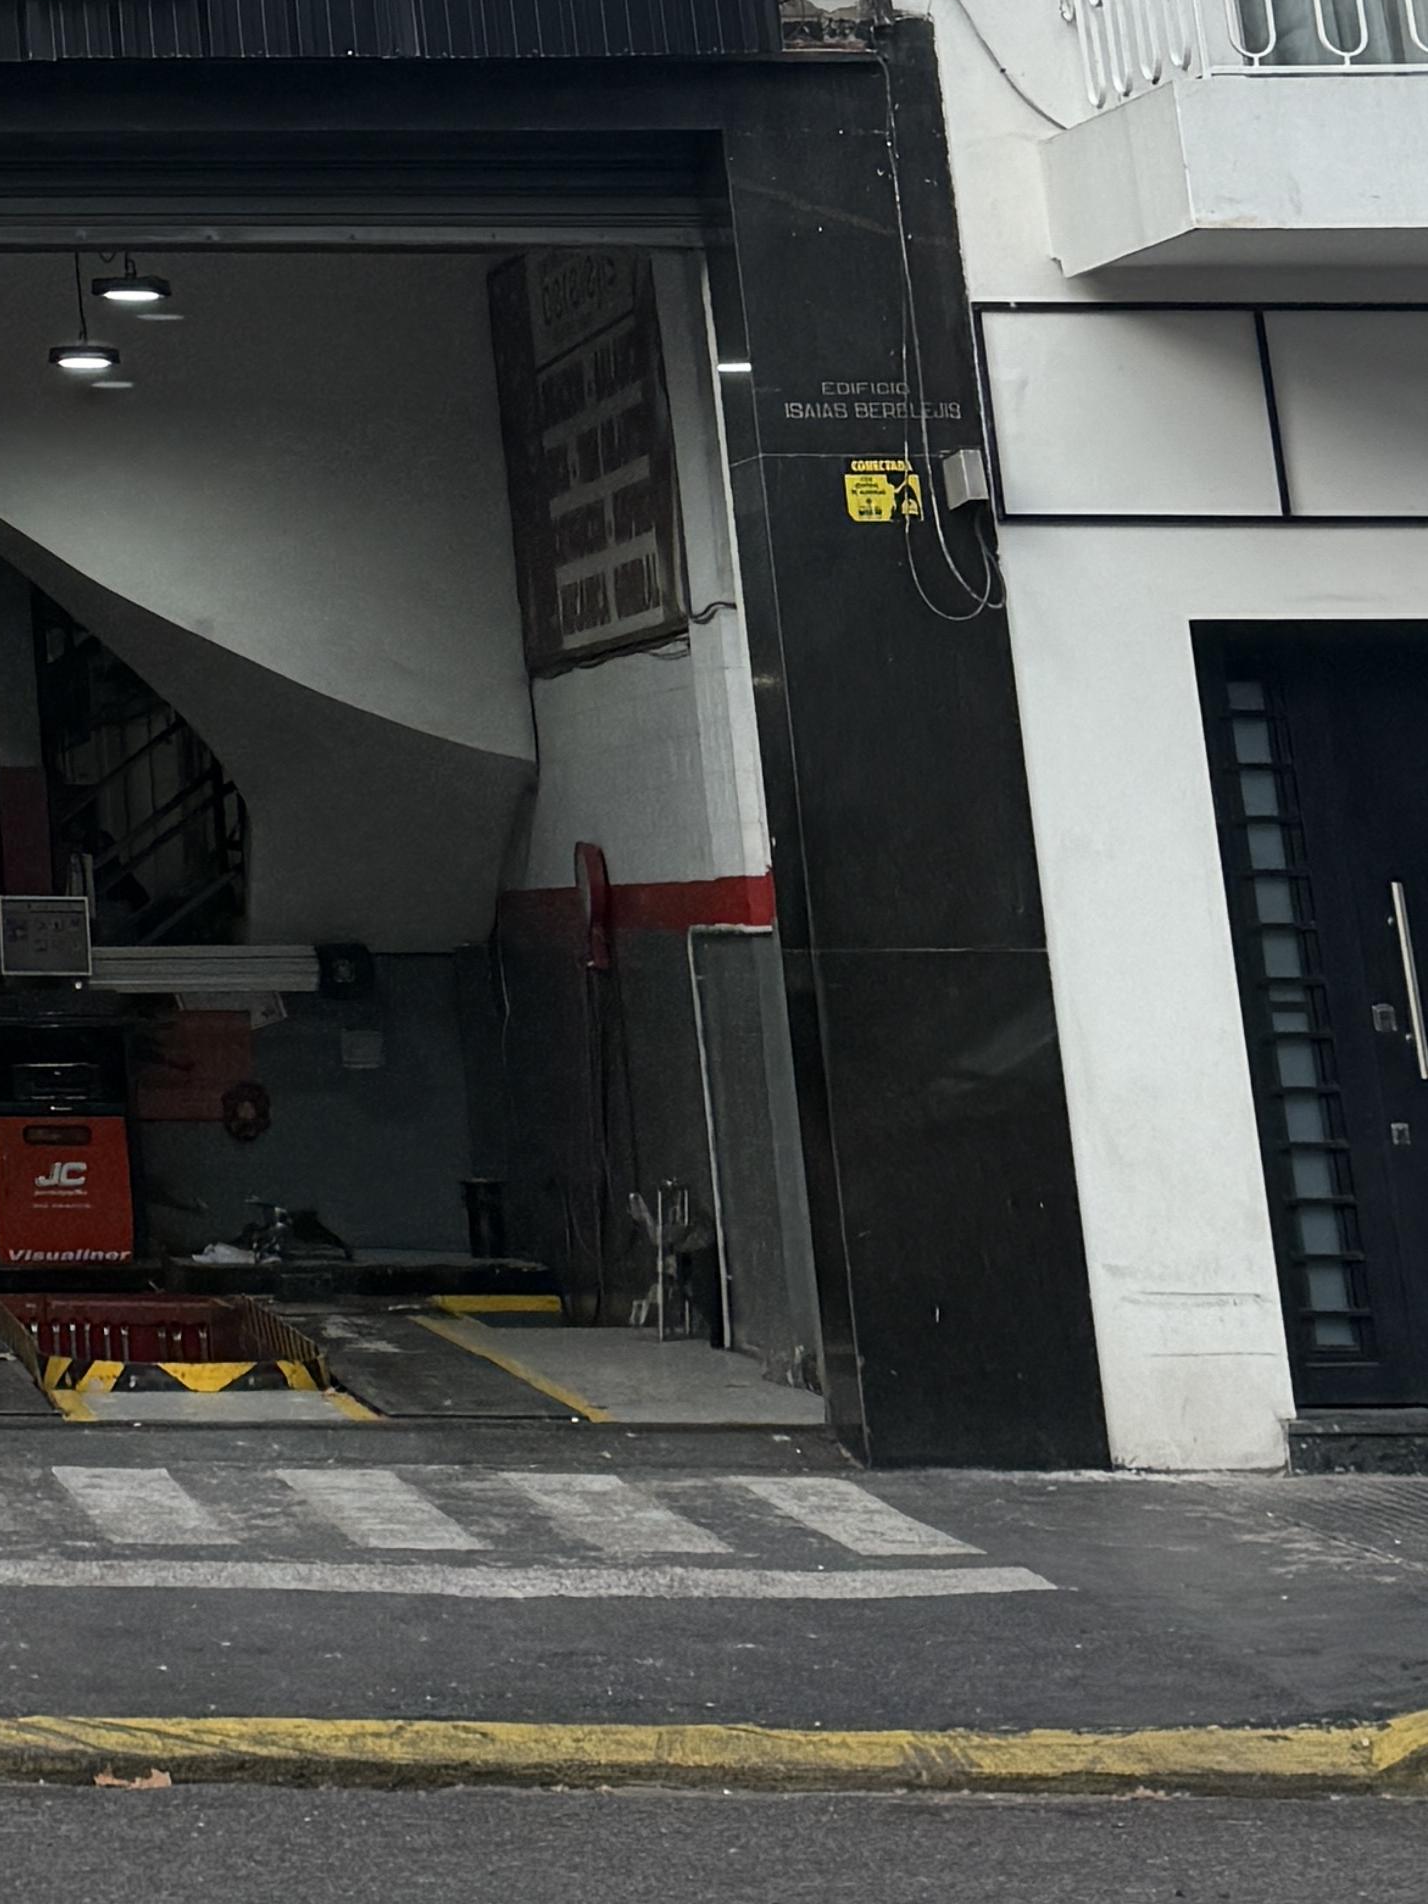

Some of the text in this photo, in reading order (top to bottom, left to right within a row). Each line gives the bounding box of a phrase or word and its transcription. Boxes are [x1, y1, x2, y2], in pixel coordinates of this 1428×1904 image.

[821, 381, 911, 395] EDIFICIO
[784, 402, 848, 419] ISAIAS
[34, 1161, 88, 1187] JC
